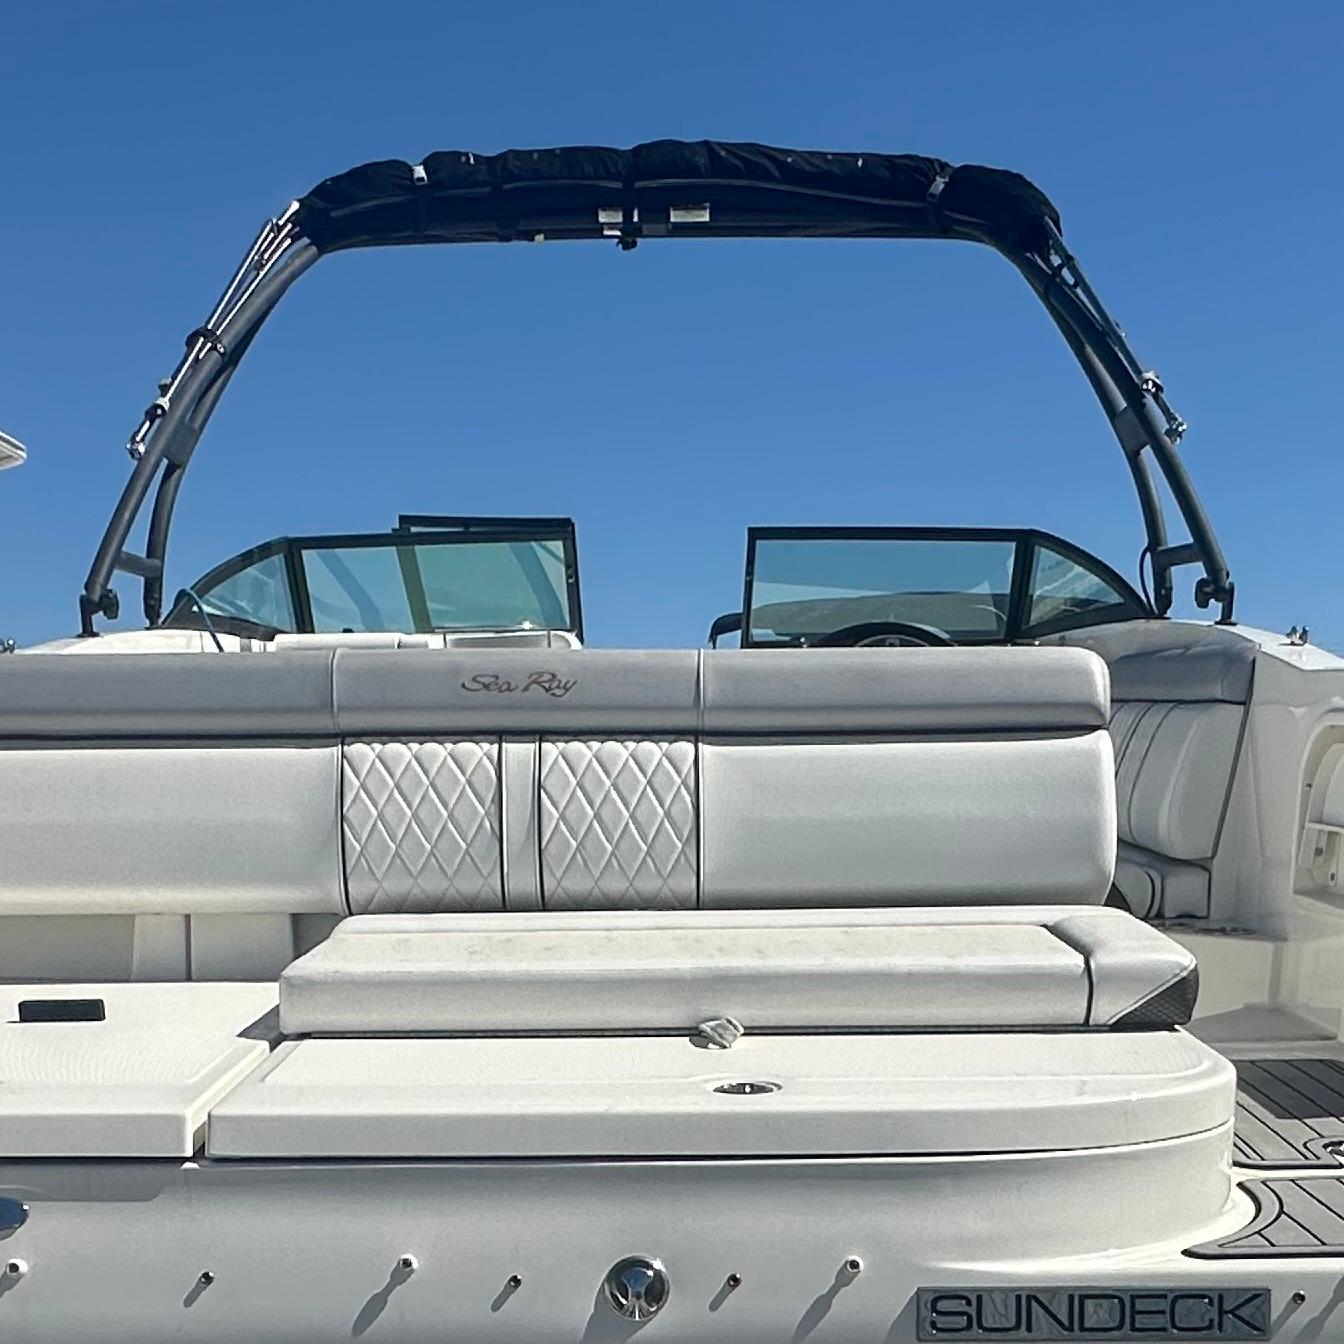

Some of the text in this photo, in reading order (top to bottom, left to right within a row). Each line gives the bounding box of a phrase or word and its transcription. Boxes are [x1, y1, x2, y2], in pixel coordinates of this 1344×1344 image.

[461, 671, 578, 698] Sea Ray
[930, 1293, 1266, 1334] SUNDECK
